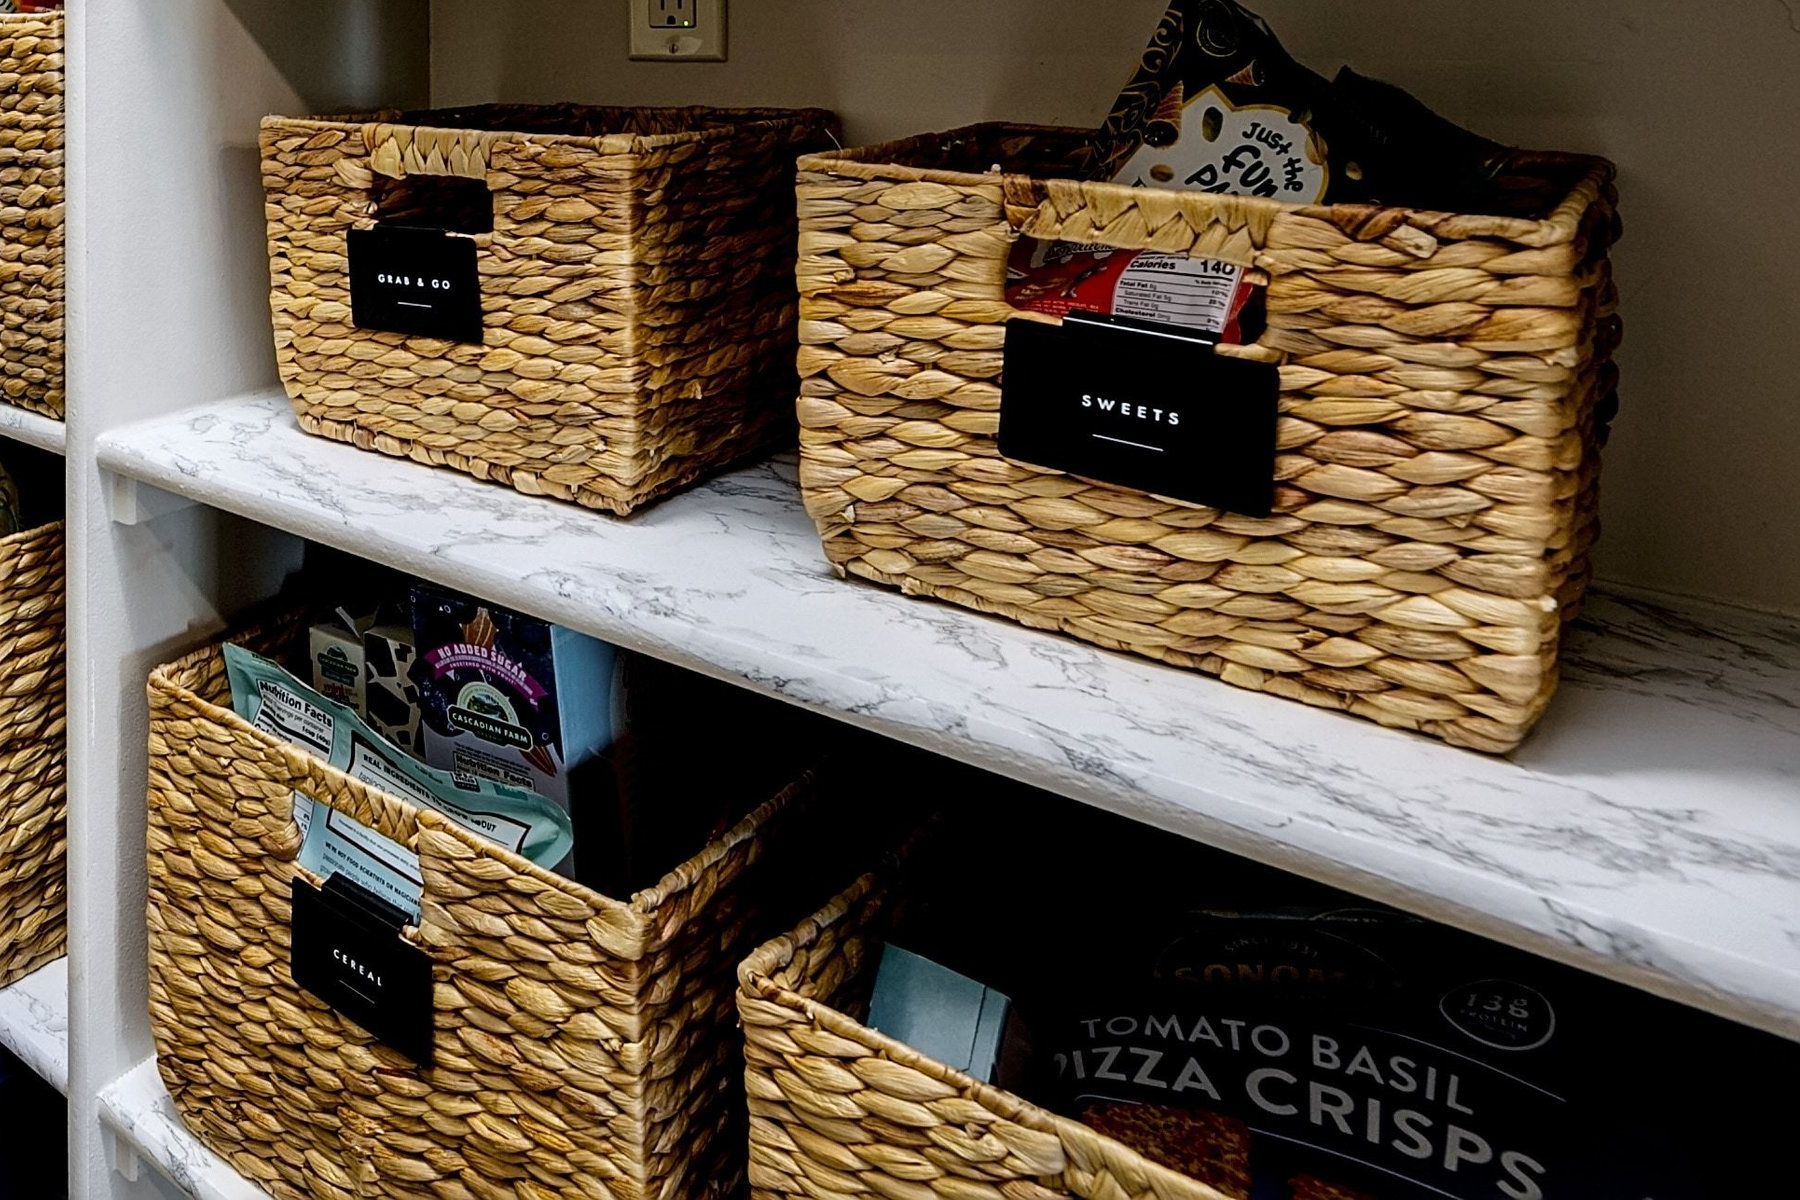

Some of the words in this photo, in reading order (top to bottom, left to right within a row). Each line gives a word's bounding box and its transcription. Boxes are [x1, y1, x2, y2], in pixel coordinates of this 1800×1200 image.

[377, 273, 410, 286] GRAB
[417, 277, 425, 287] &
[431, 278, 451, 290] GO
[1129, 259, 1177, 271] Calories
[1200, 259, 1236, 277] 140
[1081, 394, 1181, 425] SWEETS
[437, 646, 452, 660] NO
[453, 643, 488, 658] ADDED
[490, 649, 528, 682] SUGAR
[259, 680, 302, 711] Nutrition
[304, 702, 333, 728] Facts
[451, 712, 502, 735] CASCADIAN
[503, 728, 528, 744] FARM
[332, 948, 382, 987] CEREAL
[1079, 1014, 1292, 1058] TOMATO
[1311, 1033, 1475, 1116] BASIL
[1245, 1067, 1548, 1200] CRISPS
